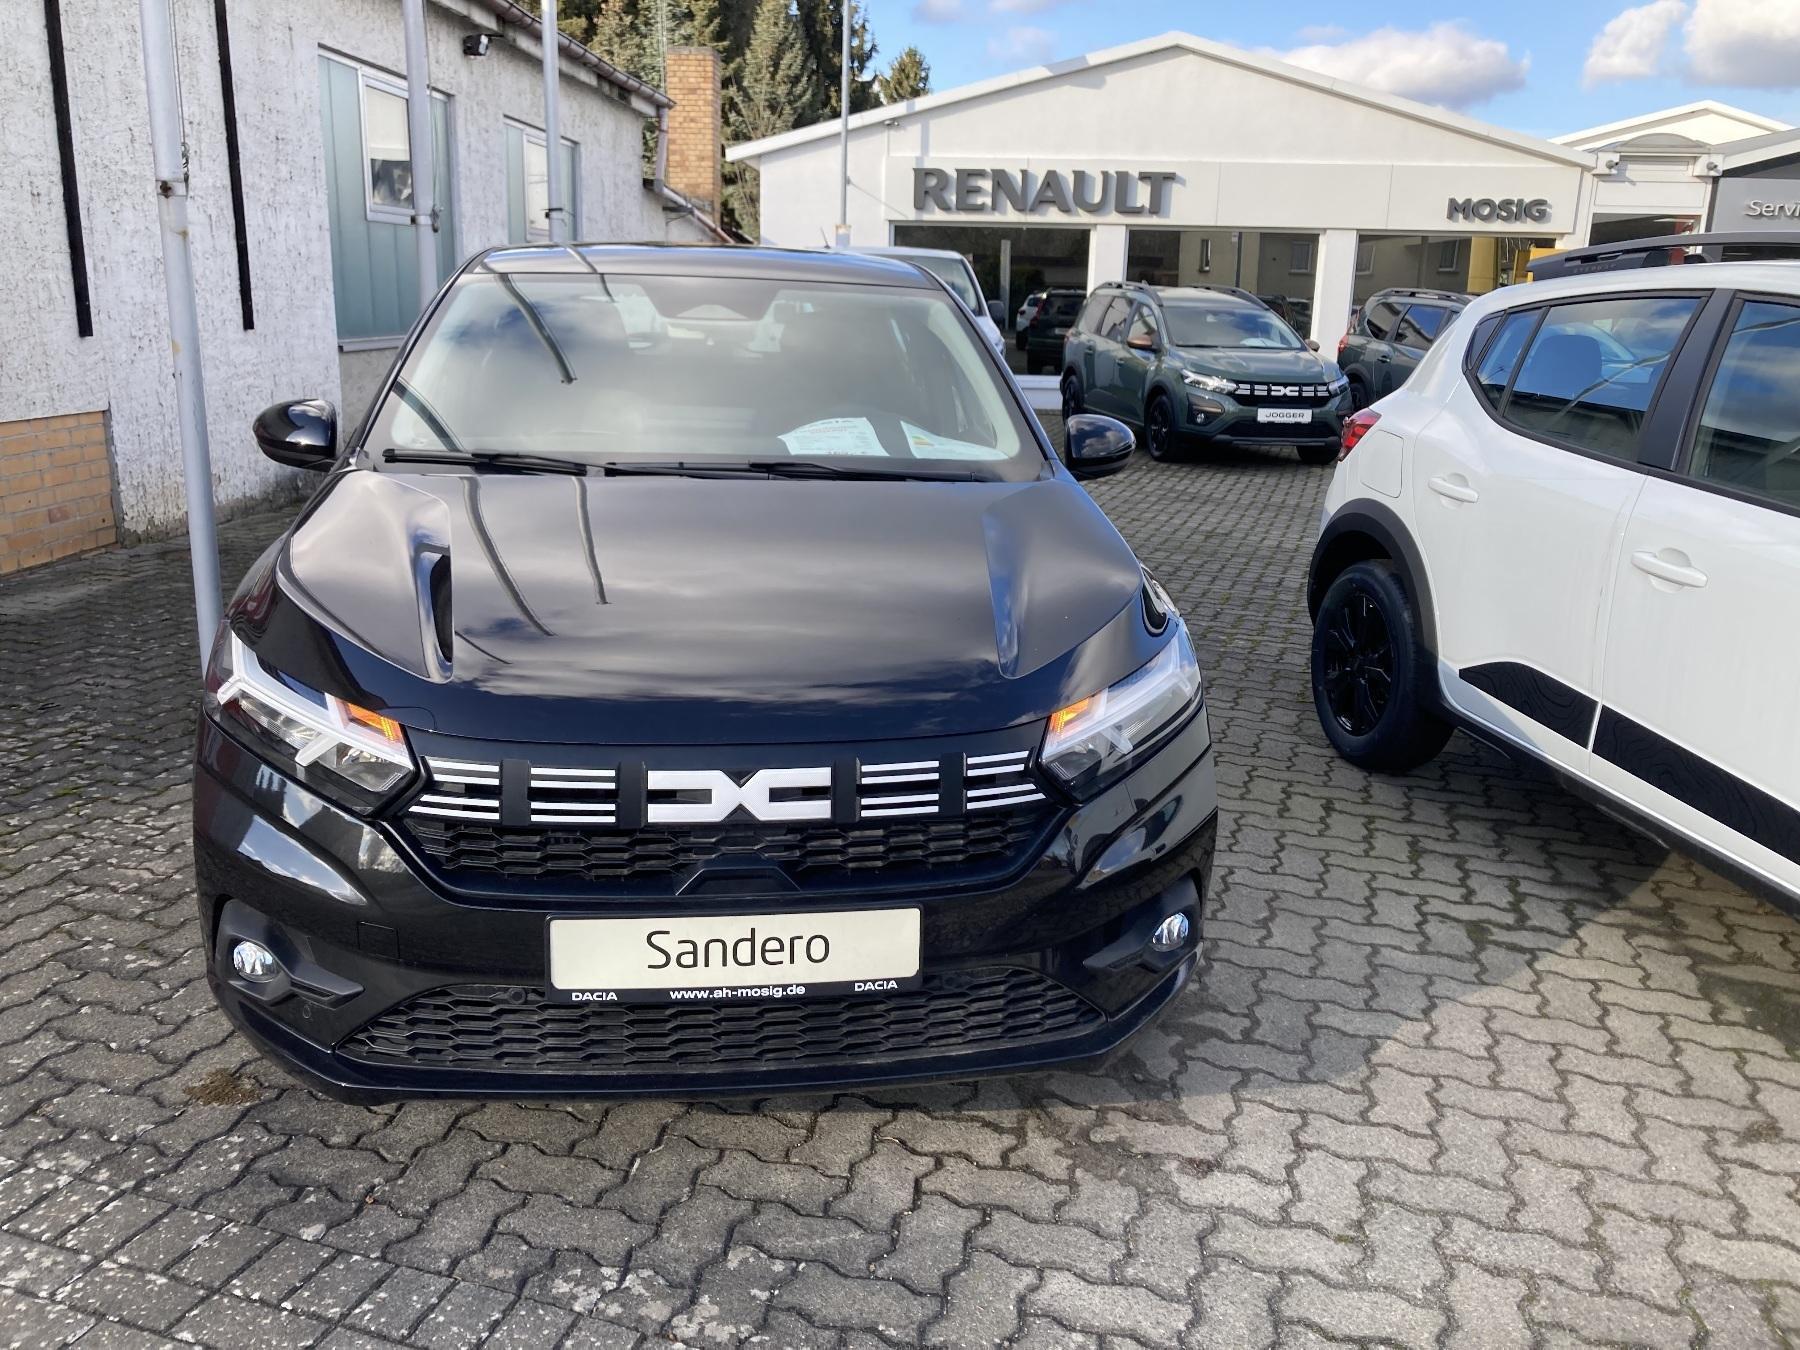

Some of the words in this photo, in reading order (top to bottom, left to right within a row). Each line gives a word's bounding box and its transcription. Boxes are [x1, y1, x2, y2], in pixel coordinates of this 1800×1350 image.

[913, 167, 1176, 214] RENAULT
[1446, 197, 1549, 222] MOSIG
[646, 927, 831, 969] Sandero
[669, 984, 807, 1000] www.ah-mosig.de
[854, 979, 899, 992] DACIA
[572, 991, 618, 1001] DACIA
